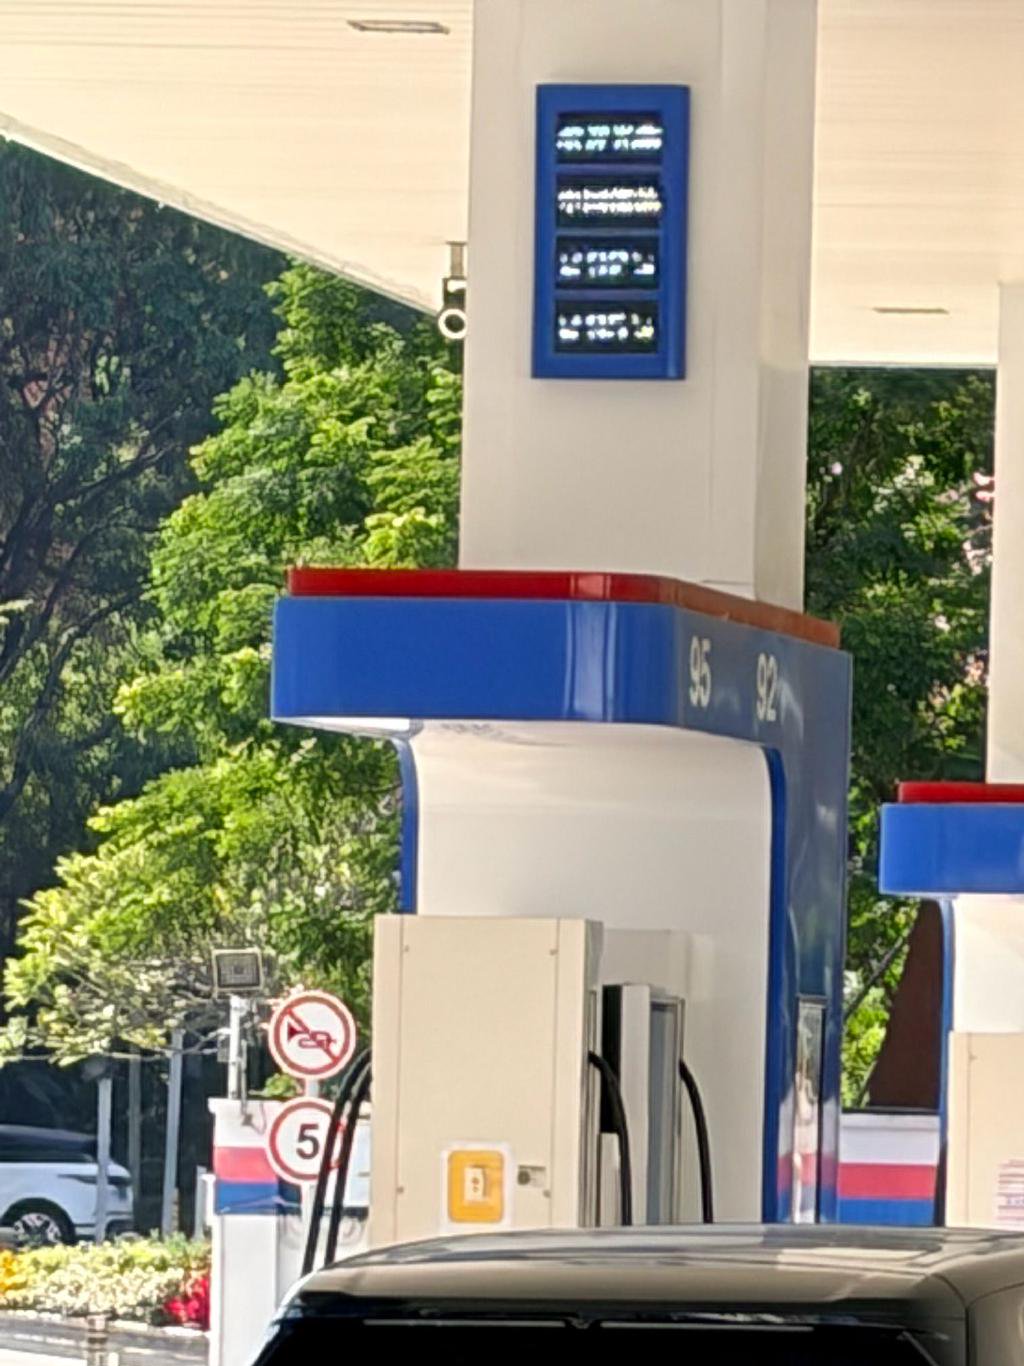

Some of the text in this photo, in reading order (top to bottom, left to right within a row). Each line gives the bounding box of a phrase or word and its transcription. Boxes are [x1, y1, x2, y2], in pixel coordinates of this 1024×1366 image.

[690, 636, 778, 721] 95 92
[296, 1123, 320, 1160] 5
